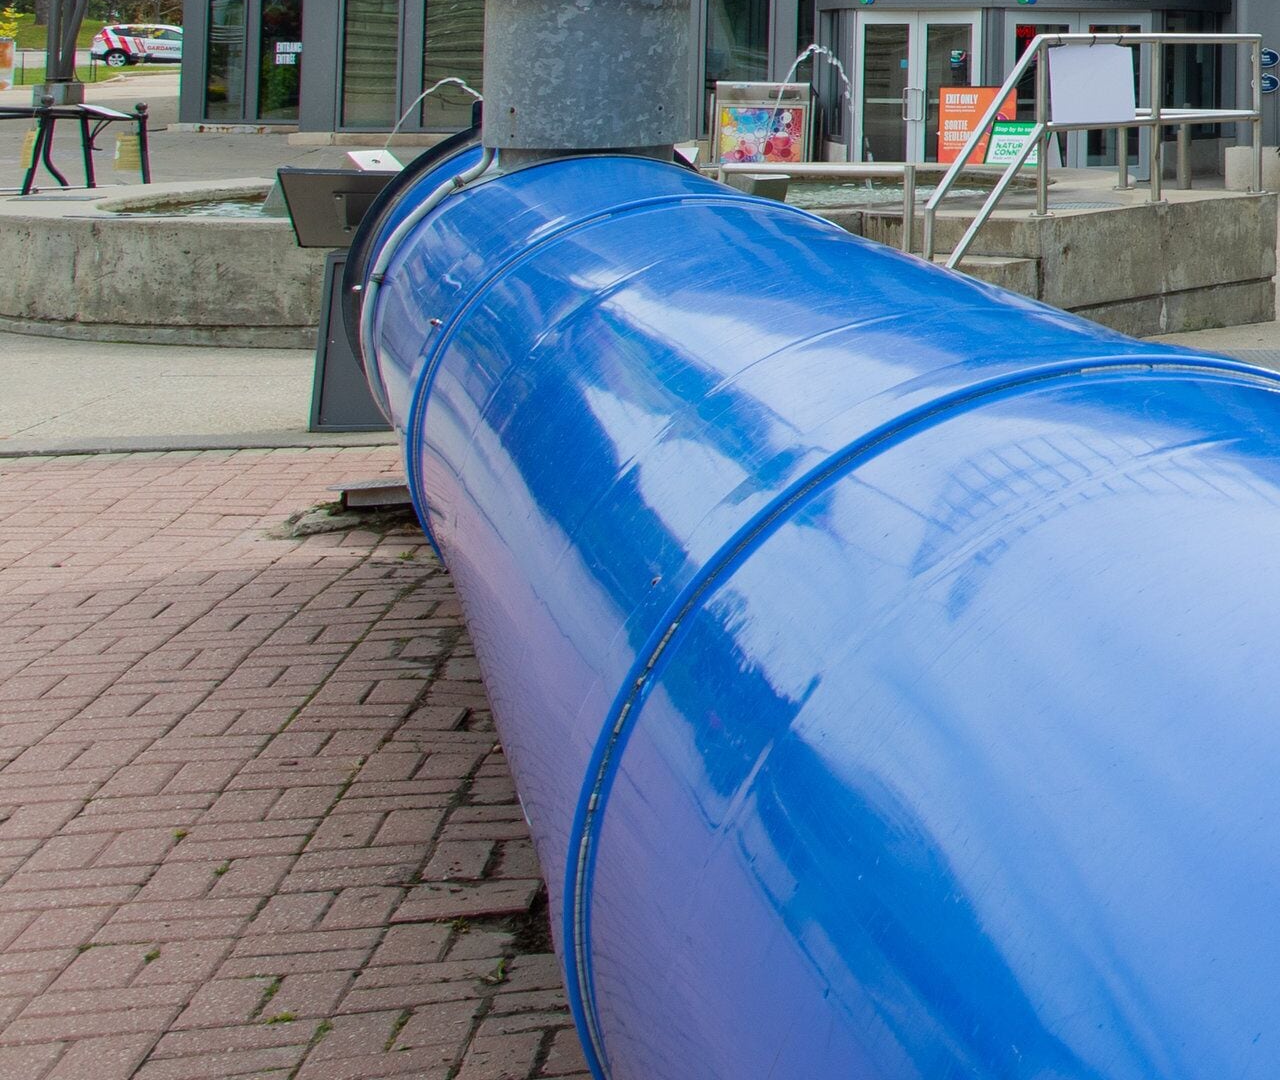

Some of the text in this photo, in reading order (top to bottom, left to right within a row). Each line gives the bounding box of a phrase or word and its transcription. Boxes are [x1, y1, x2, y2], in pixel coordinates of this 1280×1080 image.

[945, 93, 979, 105] EXIT ONLY
[944, 120, 968, 130] SORTIE
